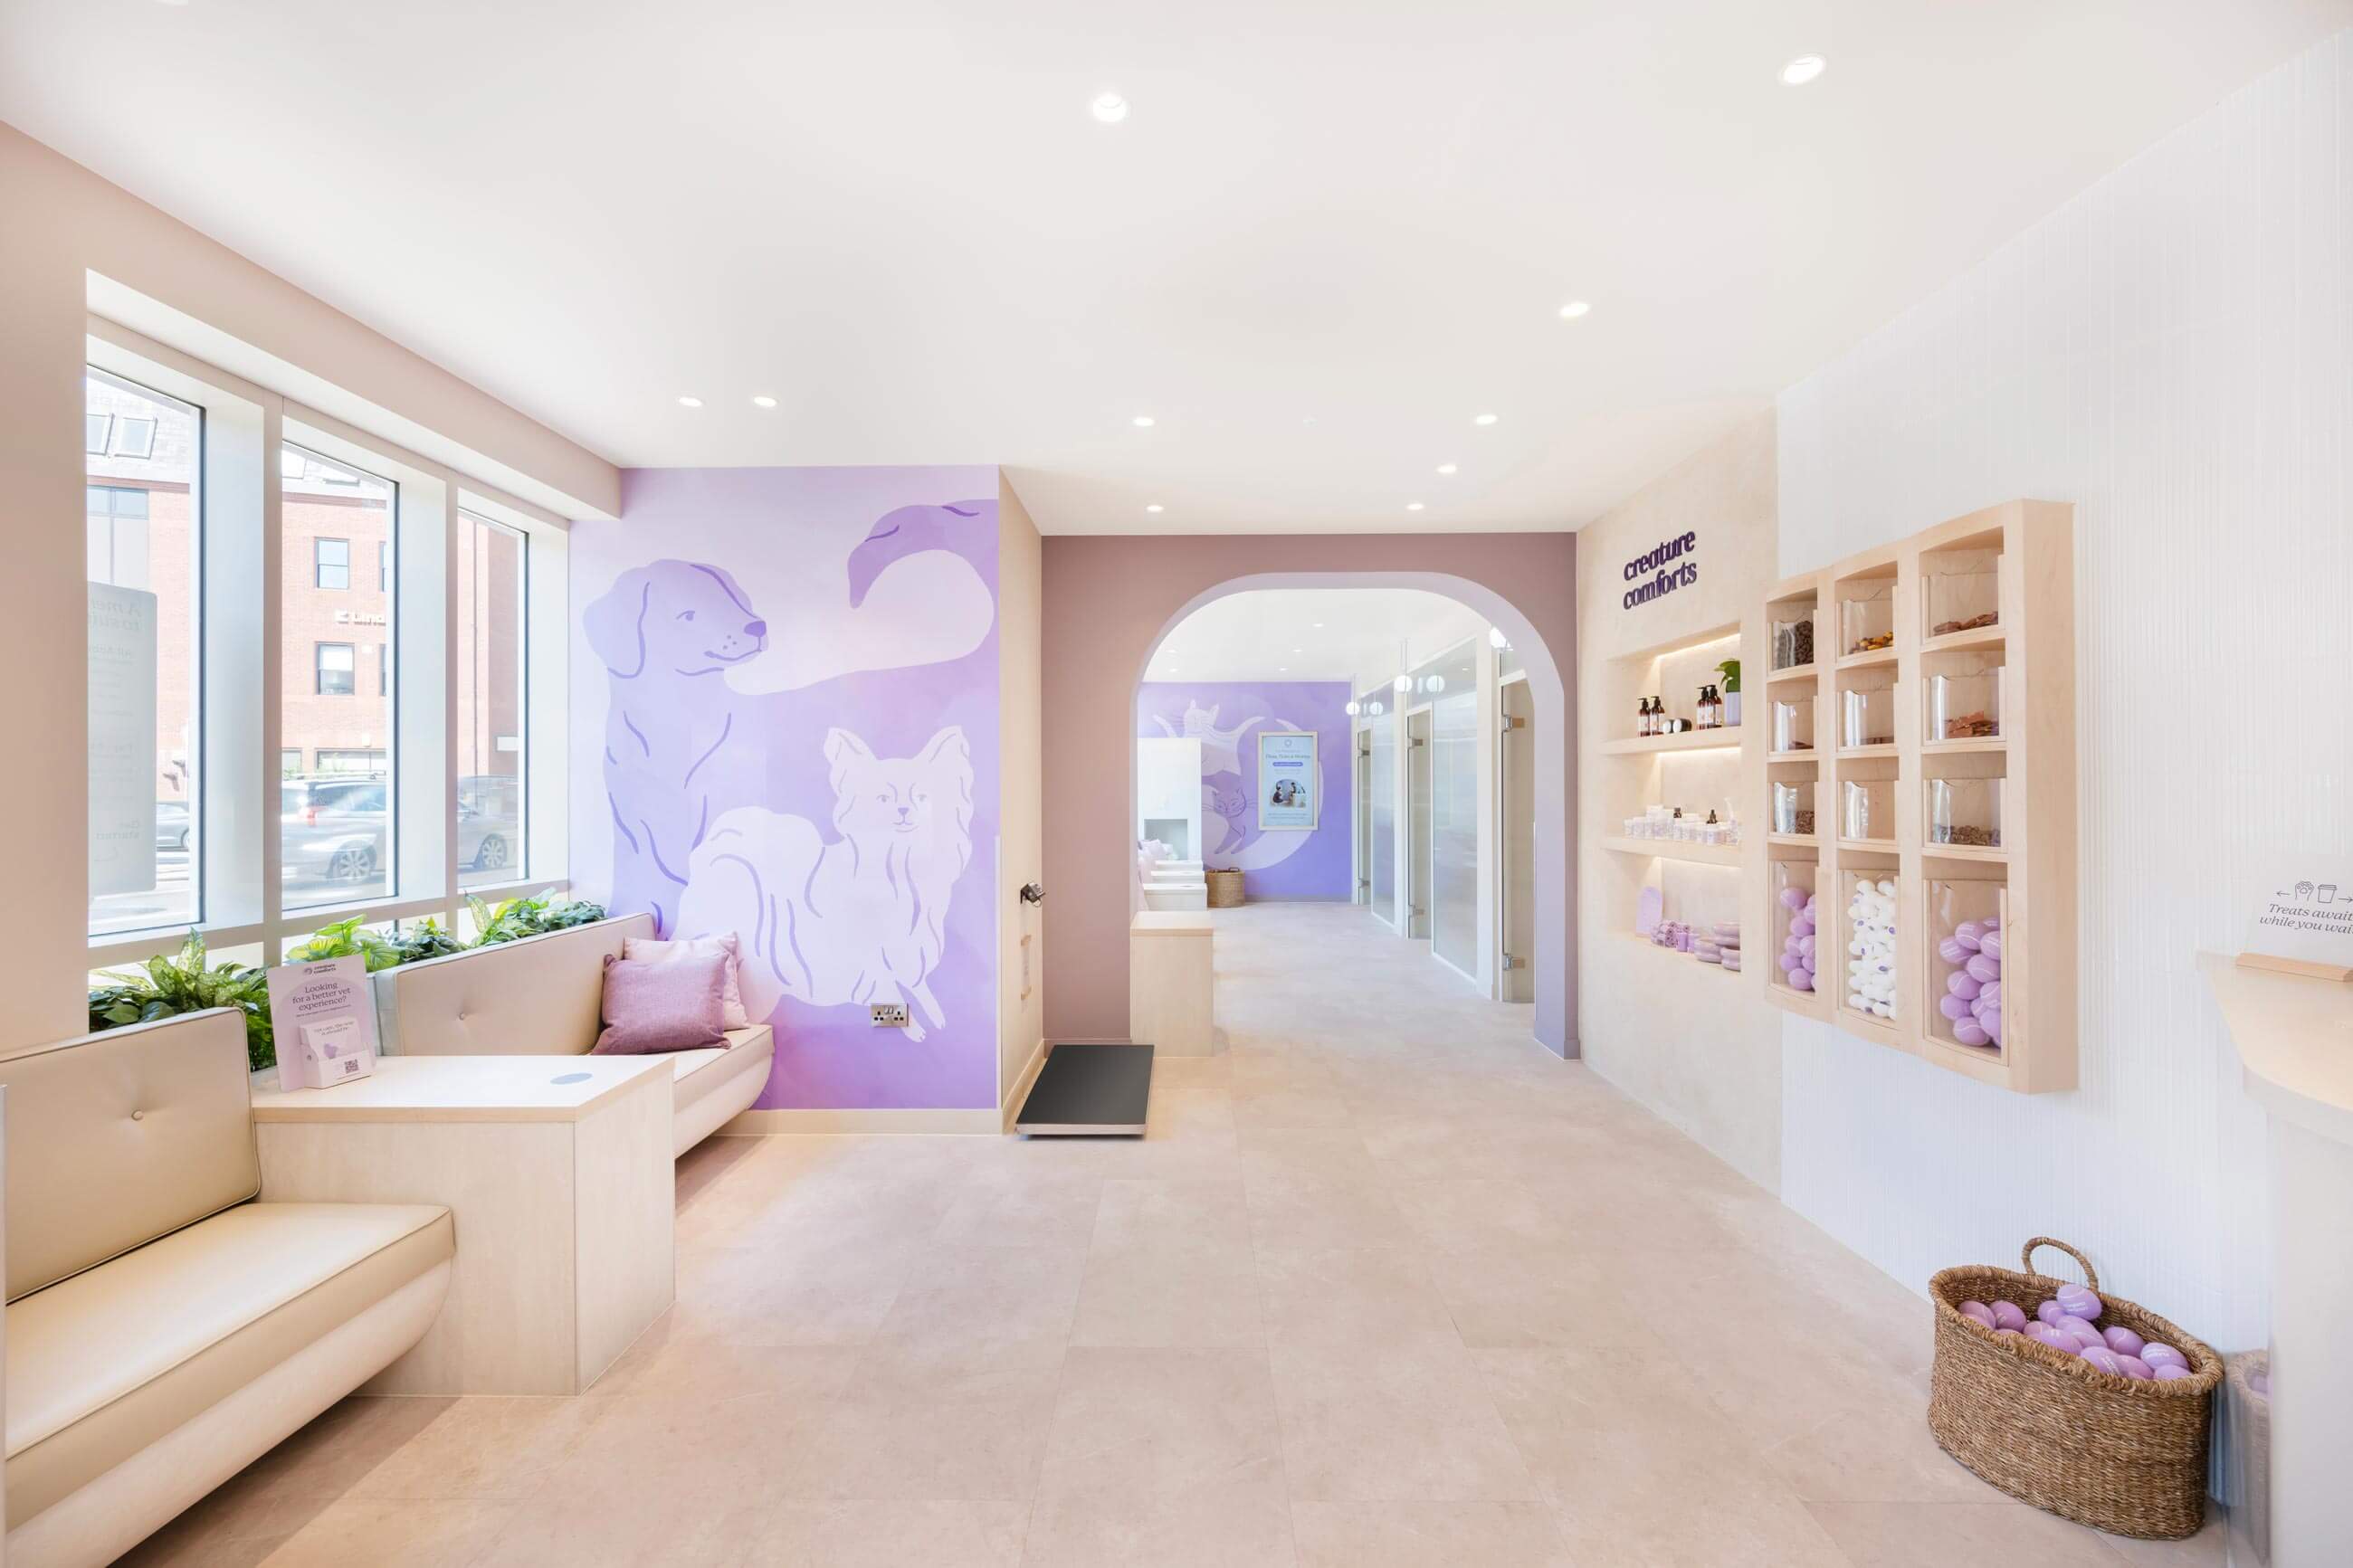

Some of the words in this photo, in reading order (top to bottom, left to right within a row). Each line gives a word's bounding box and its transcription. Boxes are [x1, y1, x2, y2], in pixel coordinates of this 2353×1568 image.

[1624, 530, 1696, 581] creature
[1623, 561, 1697, 610] comforts
[2269, 903, 2310, 917] Treats
[2311, 910, 2353, 922] await
[2260, 916, 2296, 927] while
[2294, 920, 2323, 930] you
[2325, 924, 2353, 935] wai
[291, 995, 304, 1004] for
[311, 990, 338, 1001] better
[338, 987, 352, 995] vet
[304, 983, 338, 993] Looking
[298, 994, 348, 1012] experience?
